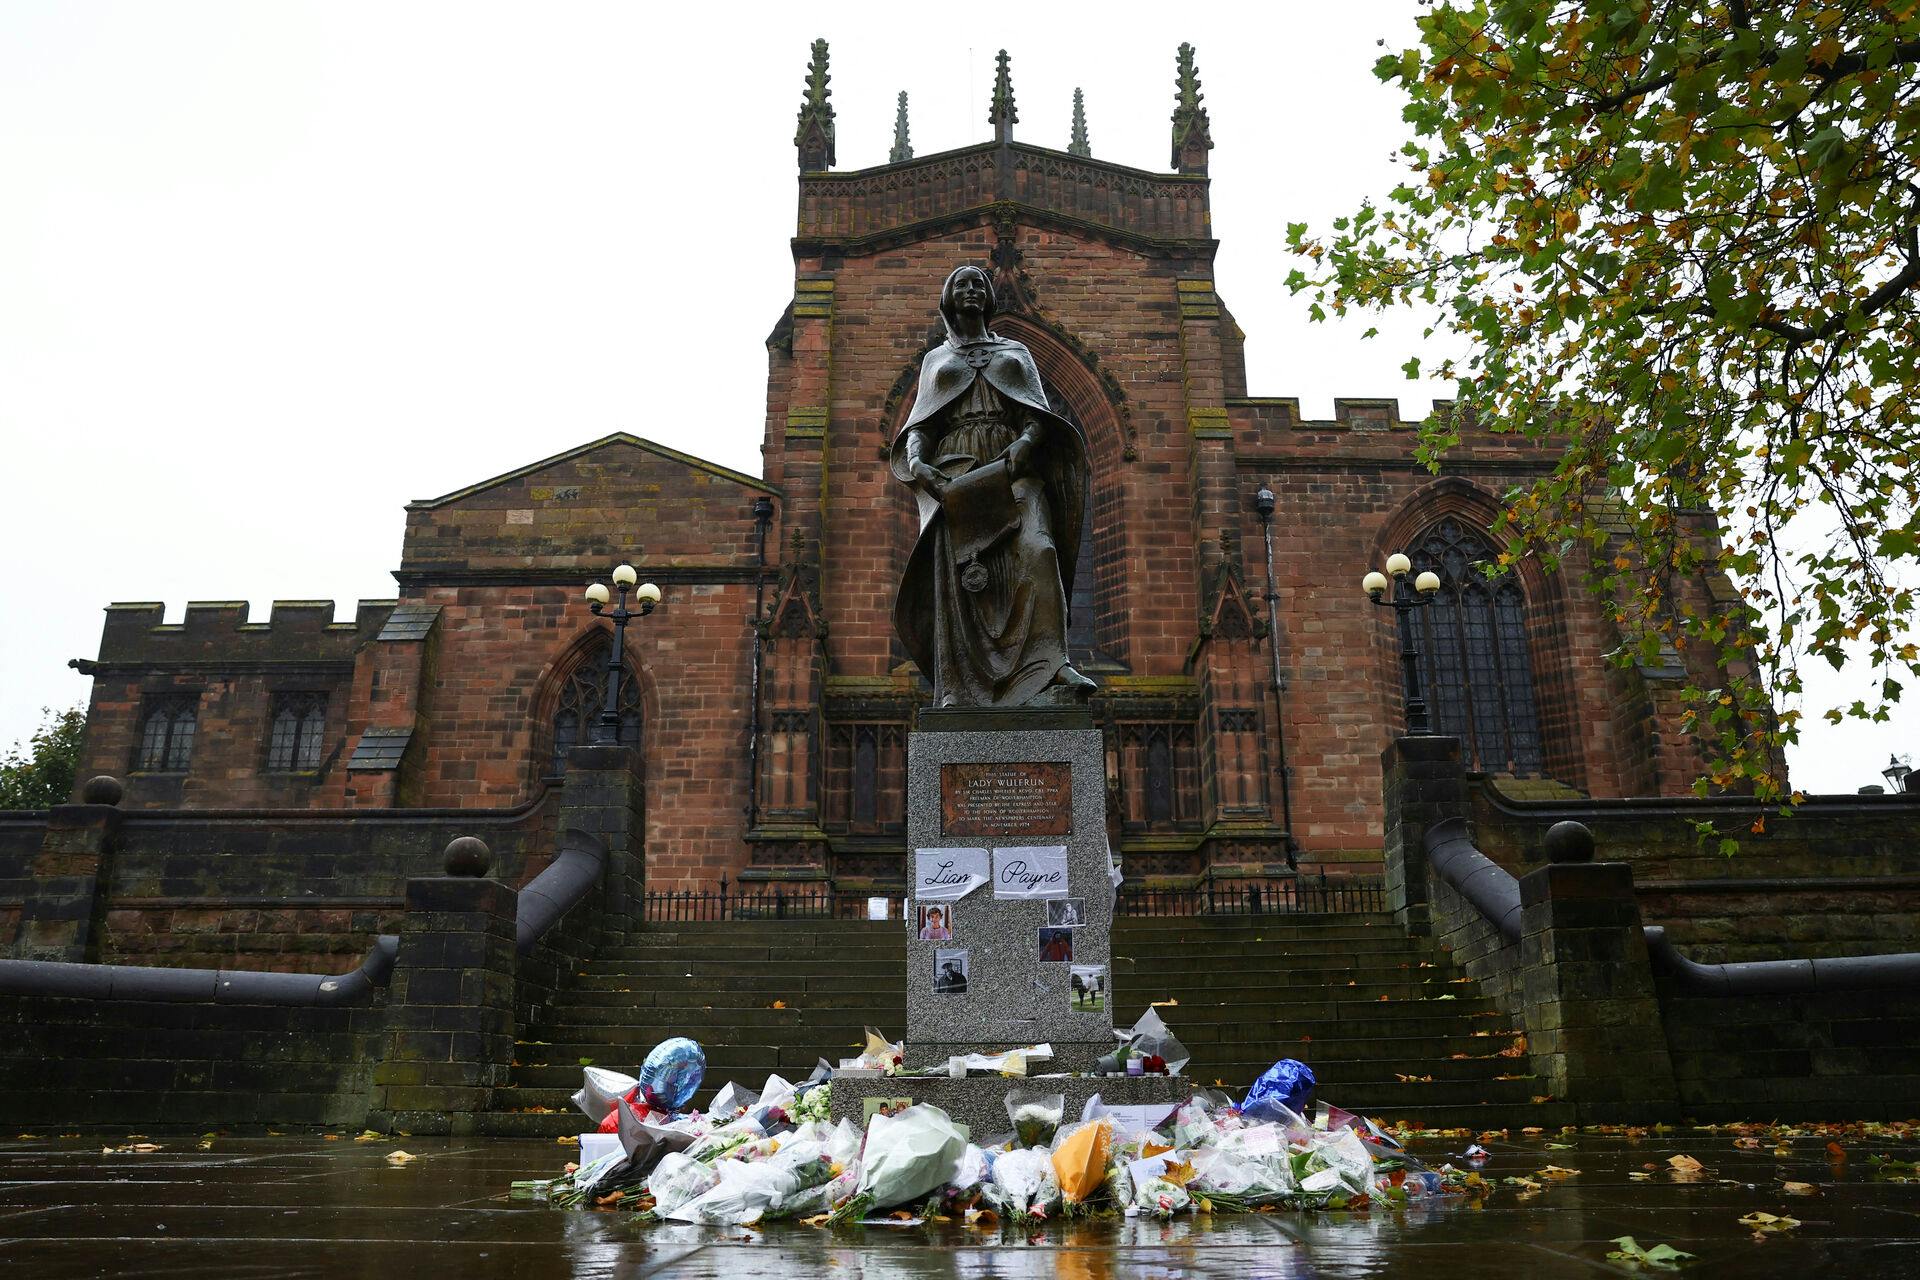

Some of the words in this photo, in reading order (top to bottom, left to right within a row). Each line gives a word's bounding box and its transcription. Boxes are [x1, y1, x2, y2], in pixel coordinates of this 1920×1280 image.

[968, 779, 992, 788] LADY
[997, 778, 1045, 787] WULFRUN
[1001, 860, 1061, 890] Payne
